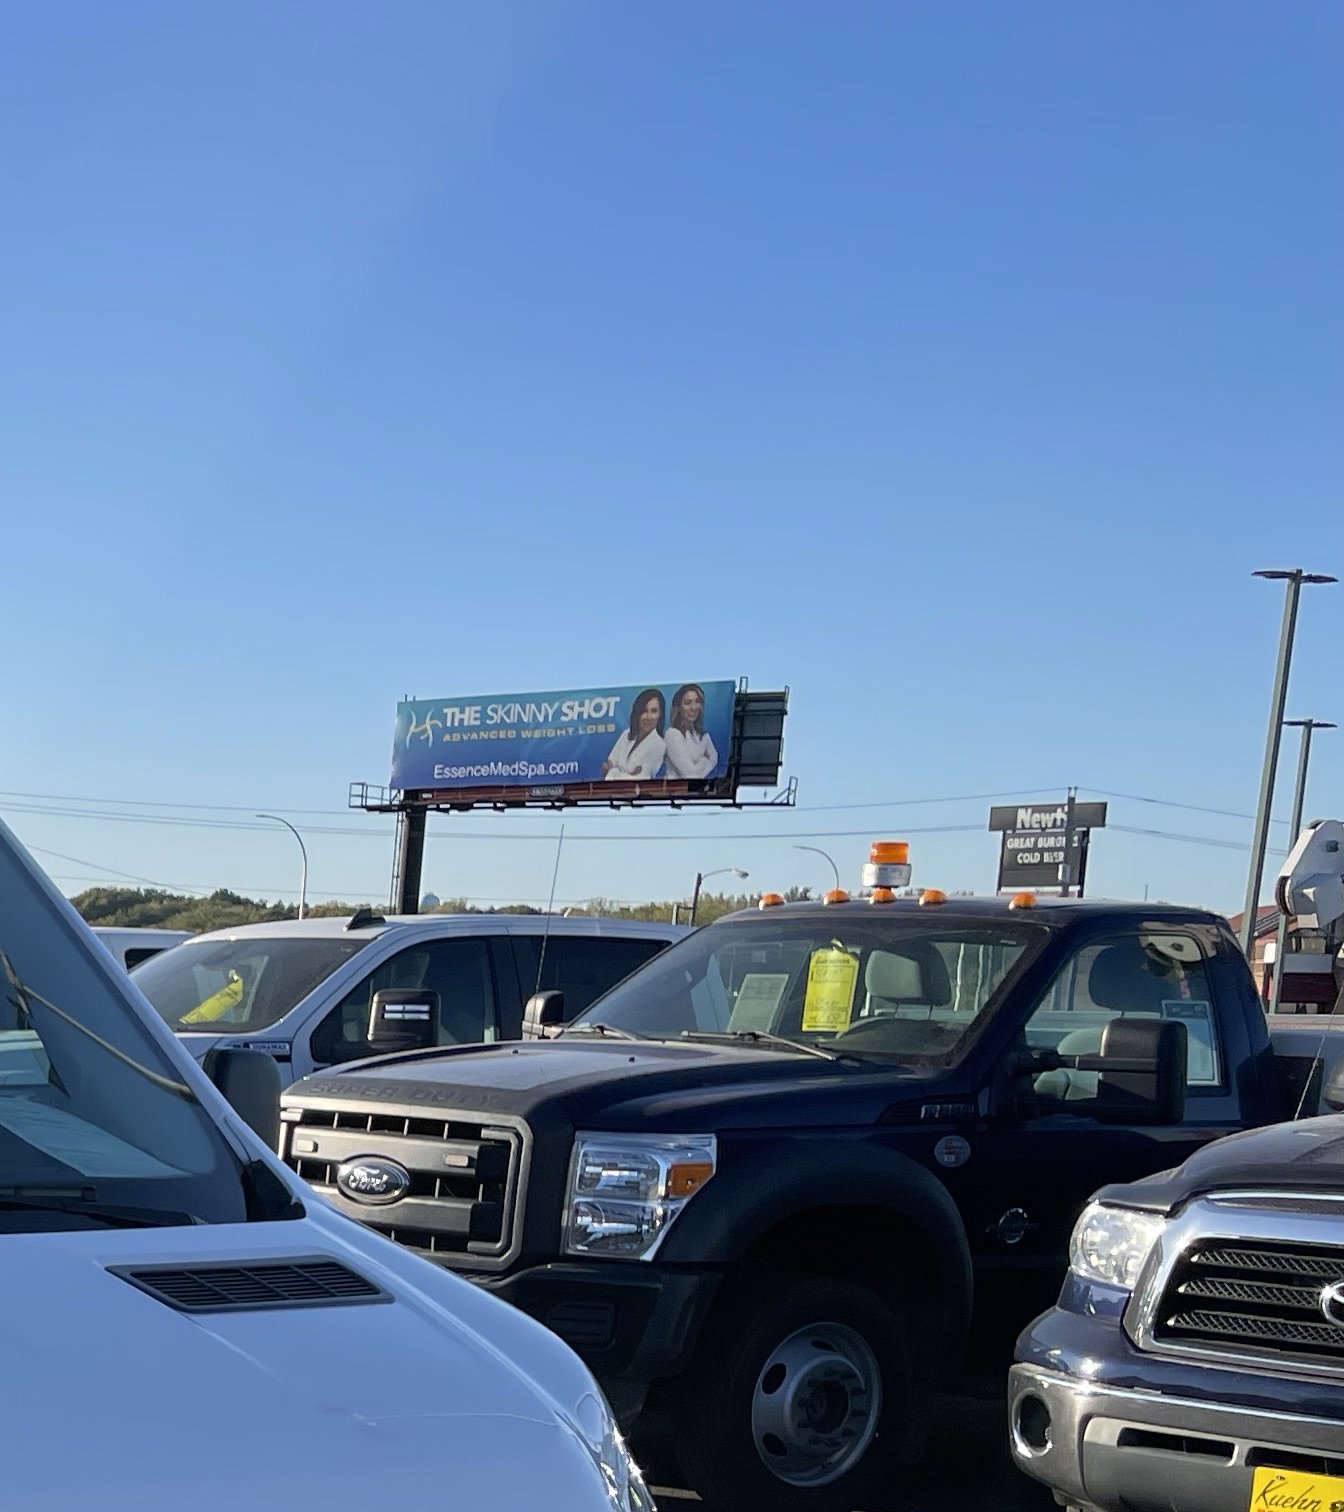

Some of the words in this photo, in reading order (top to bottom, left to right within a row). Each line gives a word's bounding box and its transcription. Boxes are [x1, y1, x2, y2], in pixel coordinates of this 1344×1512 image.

[443, 705, 482, 728] THE
[486, 701, 559, 724] SKINNY
[560, 696, 621, 722] SHOT
[442, 729, 516, 742] ADVANCED
[521, 727, 574, 739] WEIGHT
[433, 760, 579, 779] EssenceMedSpa.com
[1006, 837, 1035, 849] GREAT
[1016, 852, 1040, 864] COLD
[308, 1081, 400, 1100] SUPER
[348, 1166, 389, 1192] Ford
[1254, 1479, 1322, 1512] Kuehn
